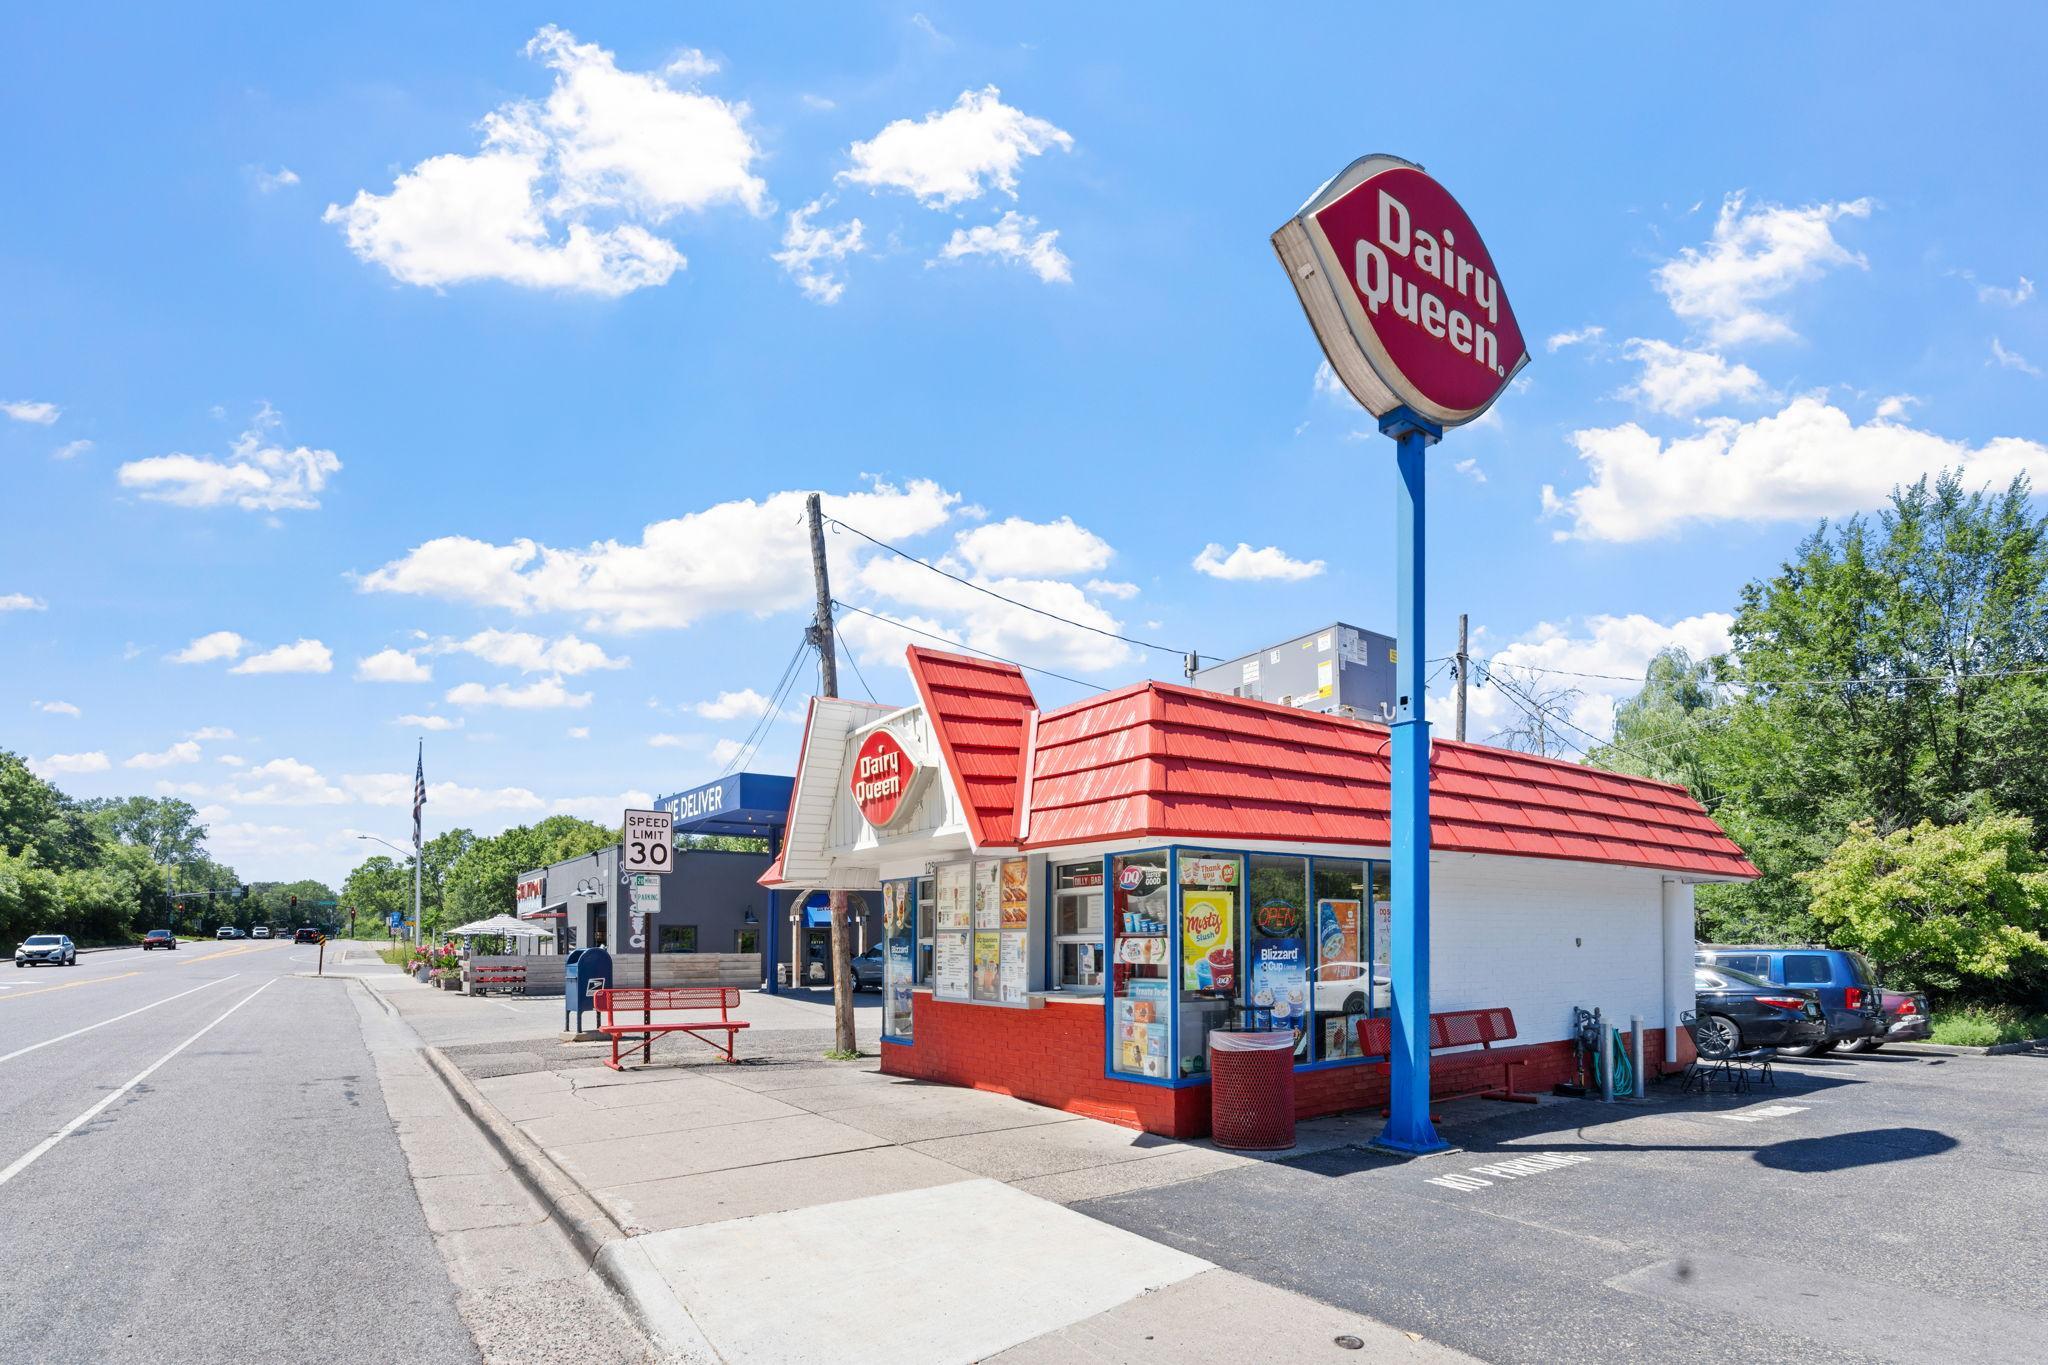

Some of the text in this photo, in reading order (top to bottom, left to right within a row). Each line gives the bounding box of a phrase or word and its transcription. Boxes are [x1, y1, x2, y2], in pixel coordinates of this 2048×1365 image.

[1378, 188, 1499, 325] Dairy
[860, 745, 900, 779] Dairy
[855, 774, 900, 807] Queen
[680, 785, 723, 820] DELIVER
[629, 816, 669, 828] SPEED
[633, 829, 664, 840] LIMIT
[629, 842, 668, 865] 30
[1201, 863, 1222, 872] Thank
[1074, 876, 1089, 886] DILLY
[1124, 871, 1140, 884] DQ
[637, 893, 659, 901] PARKING
[1185, 912, 1223, 935] Misty
[1258, 907, 1296, 927] OPEN
[1196, 932, 1215, 942] Slush
[1261, 948, 1297, 960] Blizzard
[1268, 961, 1283, 971] Cup
[1423, 1151, 1592, 1192] NO PARKING
